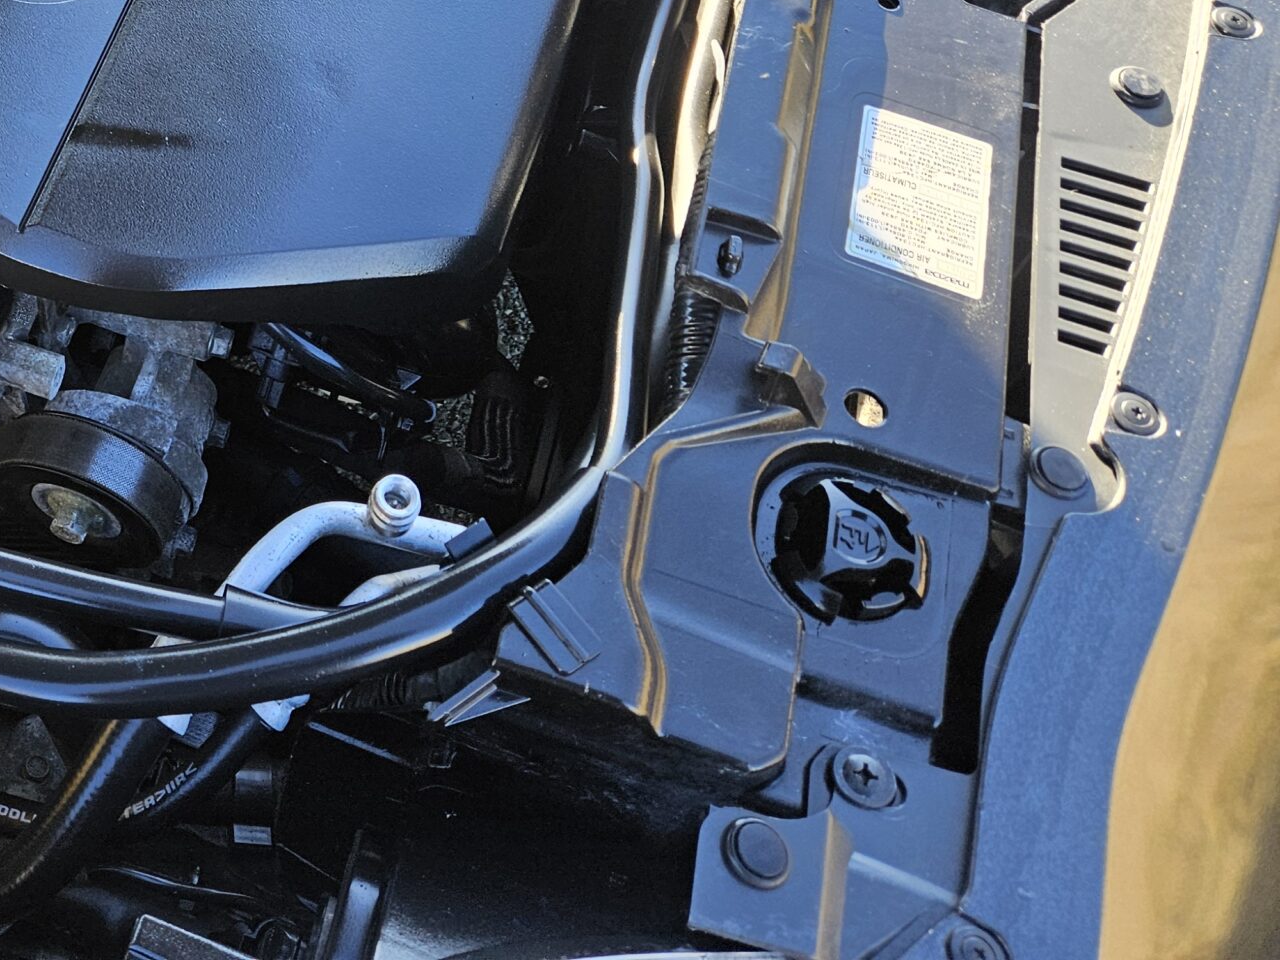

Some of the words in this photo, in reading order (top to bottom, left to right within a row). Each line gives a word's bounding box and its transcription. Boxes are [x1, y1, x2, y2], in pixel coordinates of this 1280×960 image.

[863, 166, 916, 190] CLIMATISEUR
[859, 234, 914, 259] CONDITIONER
[915, 252, 930, 264] AIR
[924, 268, 969, 289] mazda
